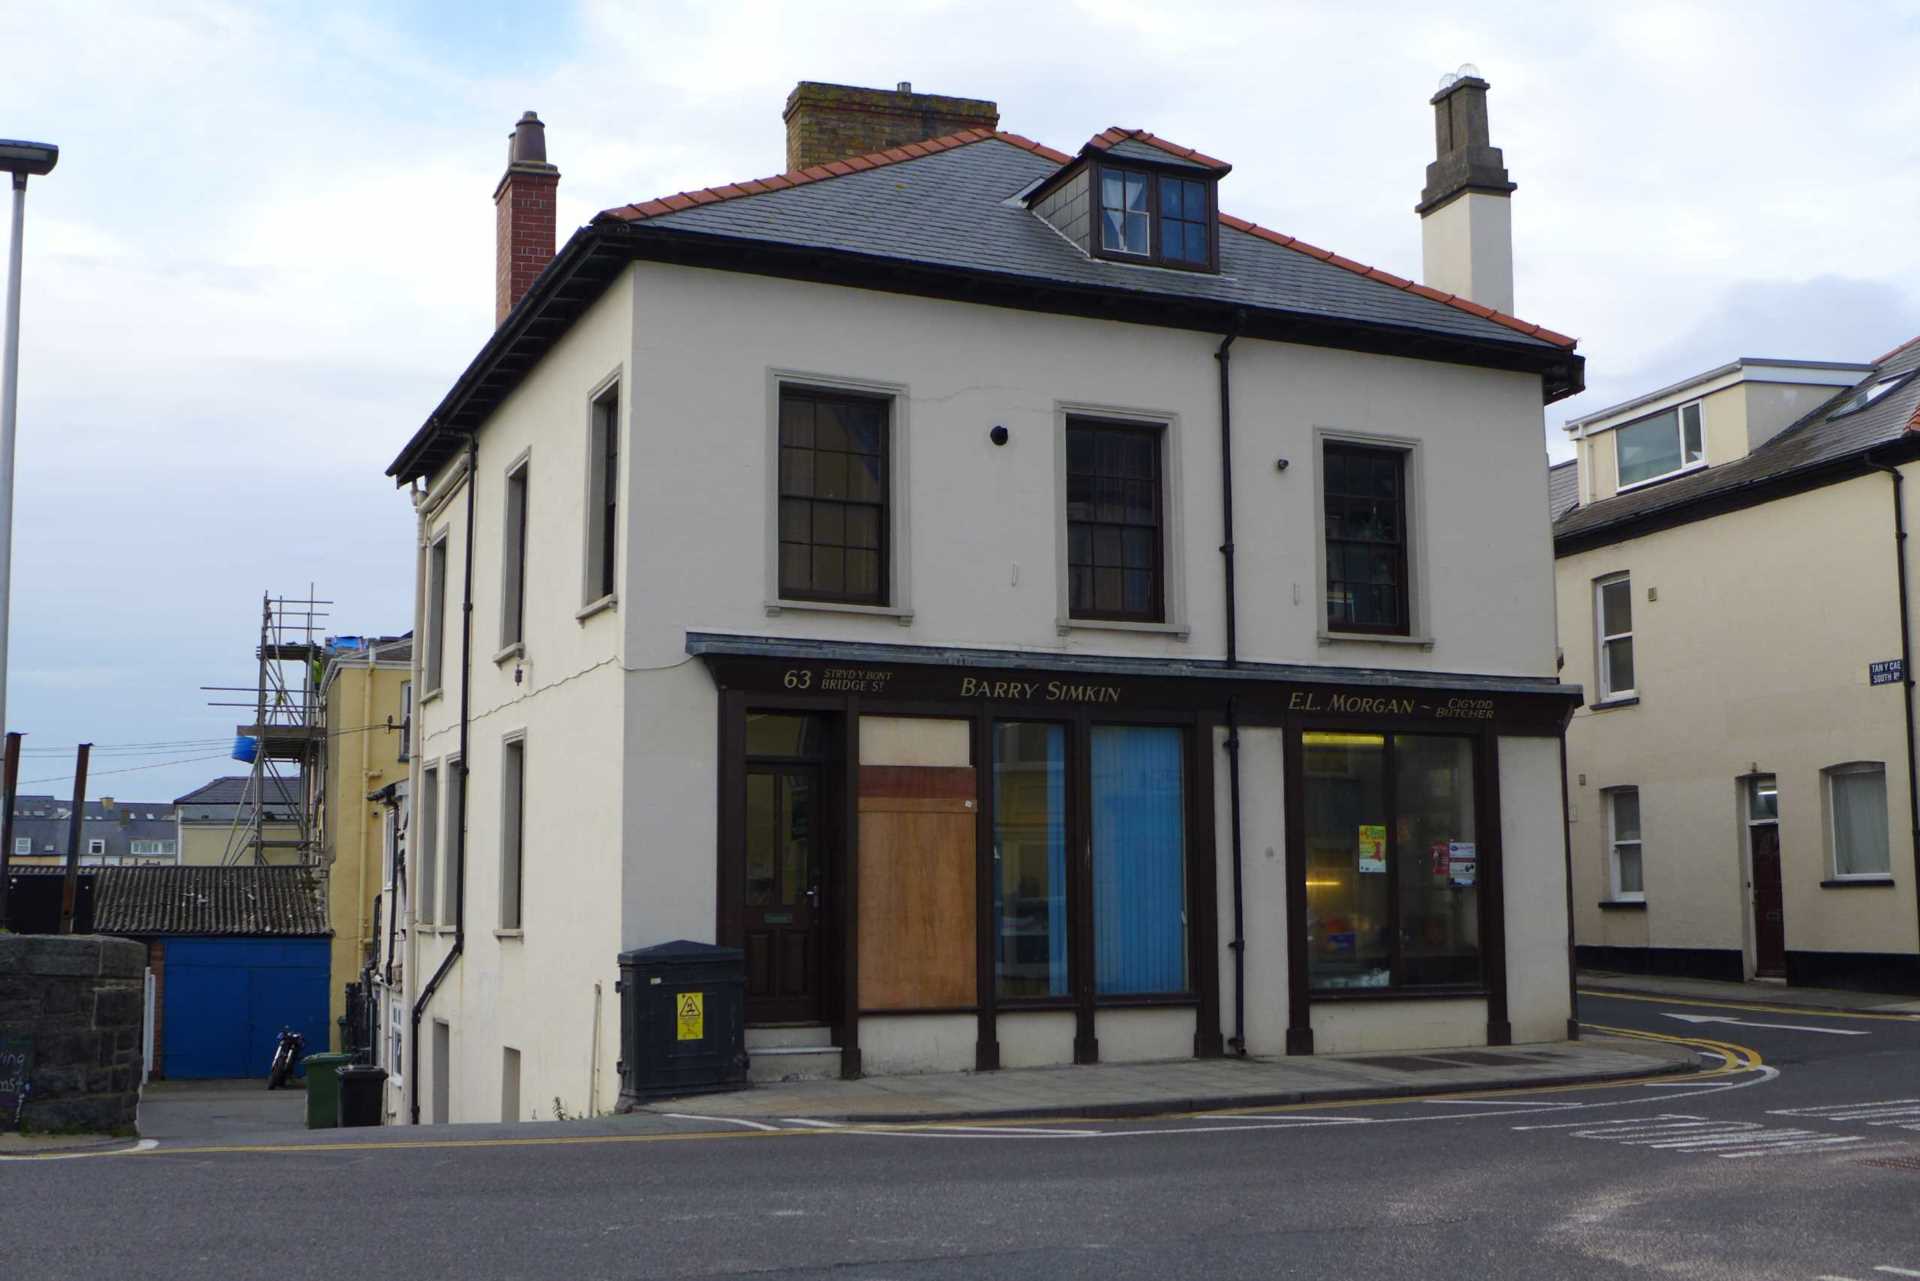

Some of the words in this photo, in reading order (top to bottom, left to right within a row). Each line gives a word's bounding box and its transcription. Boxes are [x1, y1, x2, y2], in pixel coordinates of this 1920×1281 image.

[1872, 664, 1884, 672] TAN
[1889, 661, 1901, 670] CAE
[783, 670, 812, 689] 63
[823, 668, 856, 680] STRYD
[857, 669, 865, 680] Y
[865, 671, 894, 681] BONT
[1873, 673, 1892, 683] SOUTH
[820, 679, 867, 692] BRIDGE
[960, 677, 1040, 699] BARRY
[1046, 681, 1121, 703] SIMKIN
[1327, 693, 1416, 714] MORGAN
[1447, 697, 1494, 710] CIGYDD
[1435, 707, 1495, 719] BUTCHER
